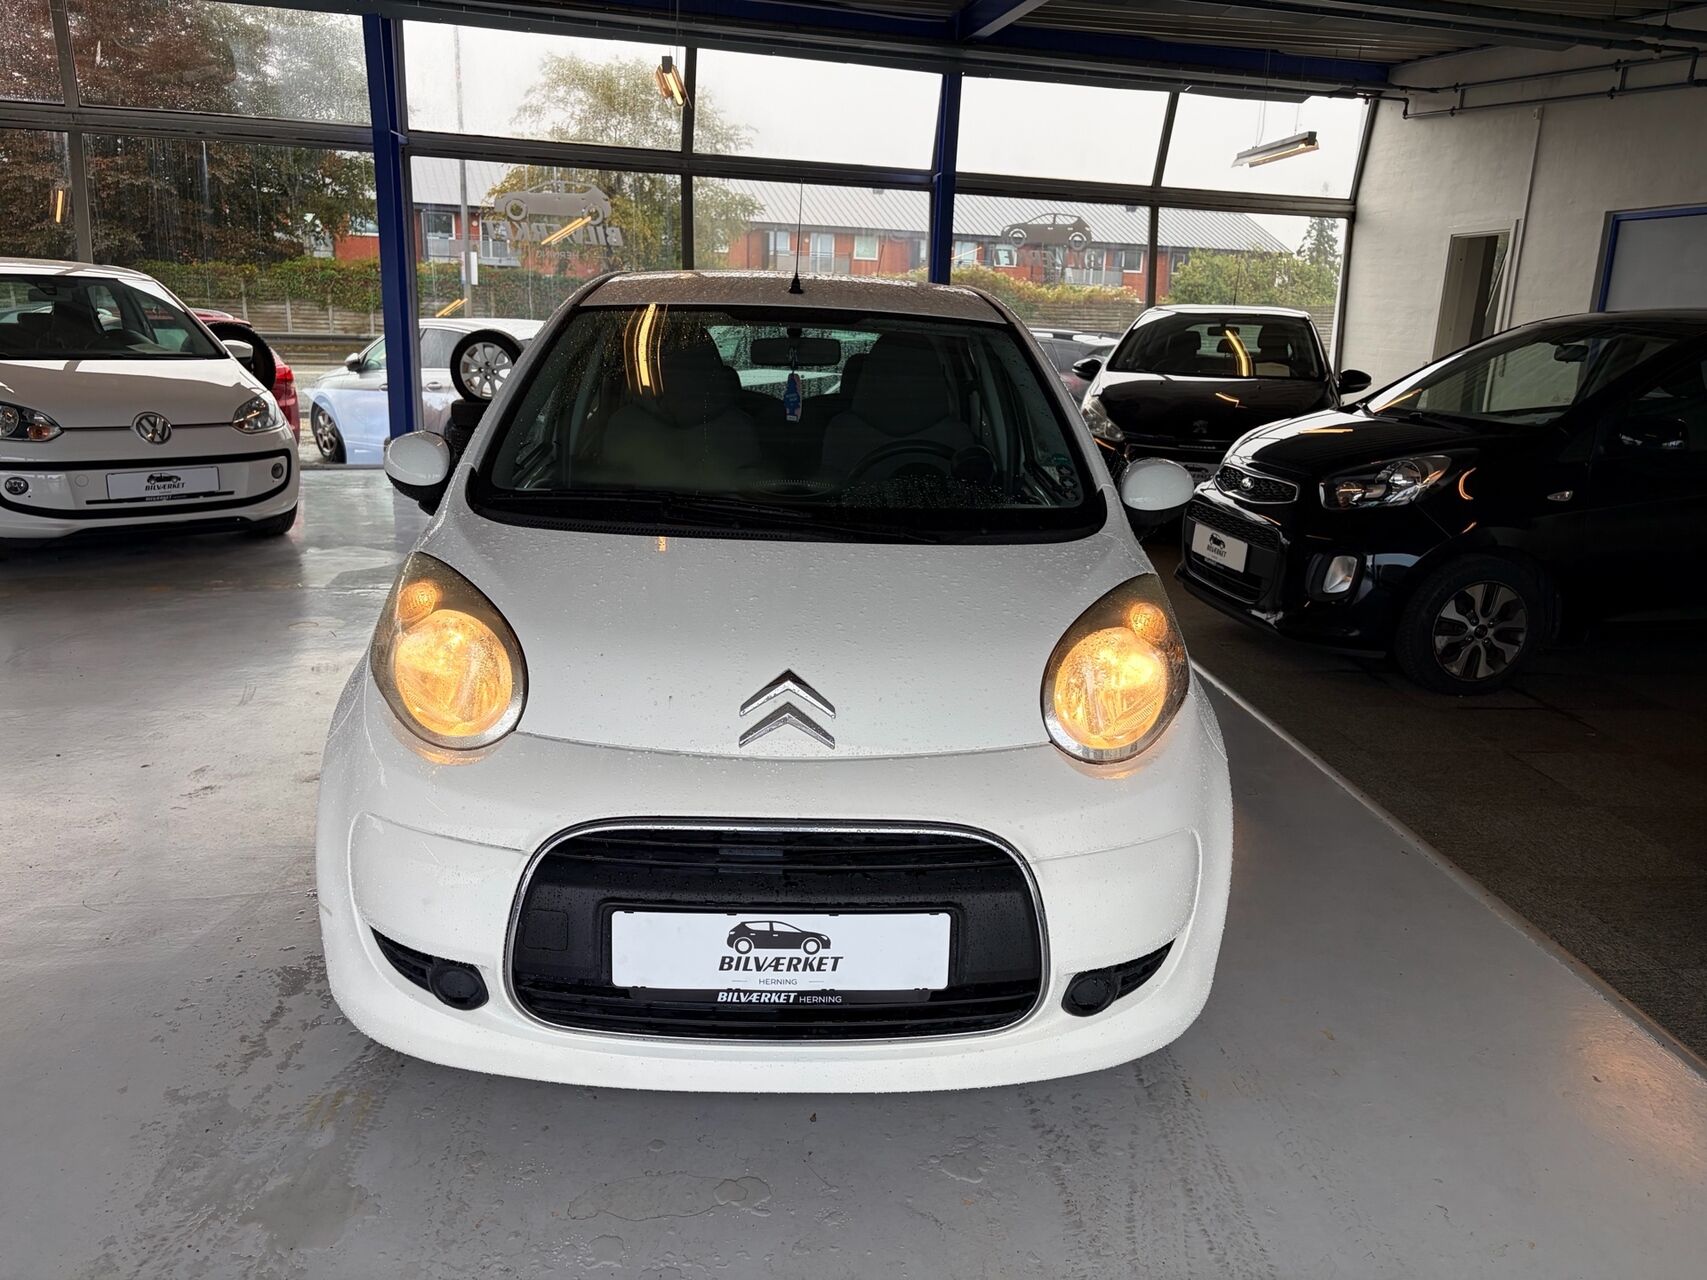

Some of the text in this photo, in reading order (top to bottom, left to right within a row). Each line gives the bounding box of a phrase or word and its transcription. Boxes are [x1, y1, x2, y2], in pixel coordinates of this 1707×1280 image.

[718, 956, 843, 972] BILVÆRKET
[758, 978, 798, 986] HERNING
[717, 992, 842, 1004] BILVÆRKET HERNING
